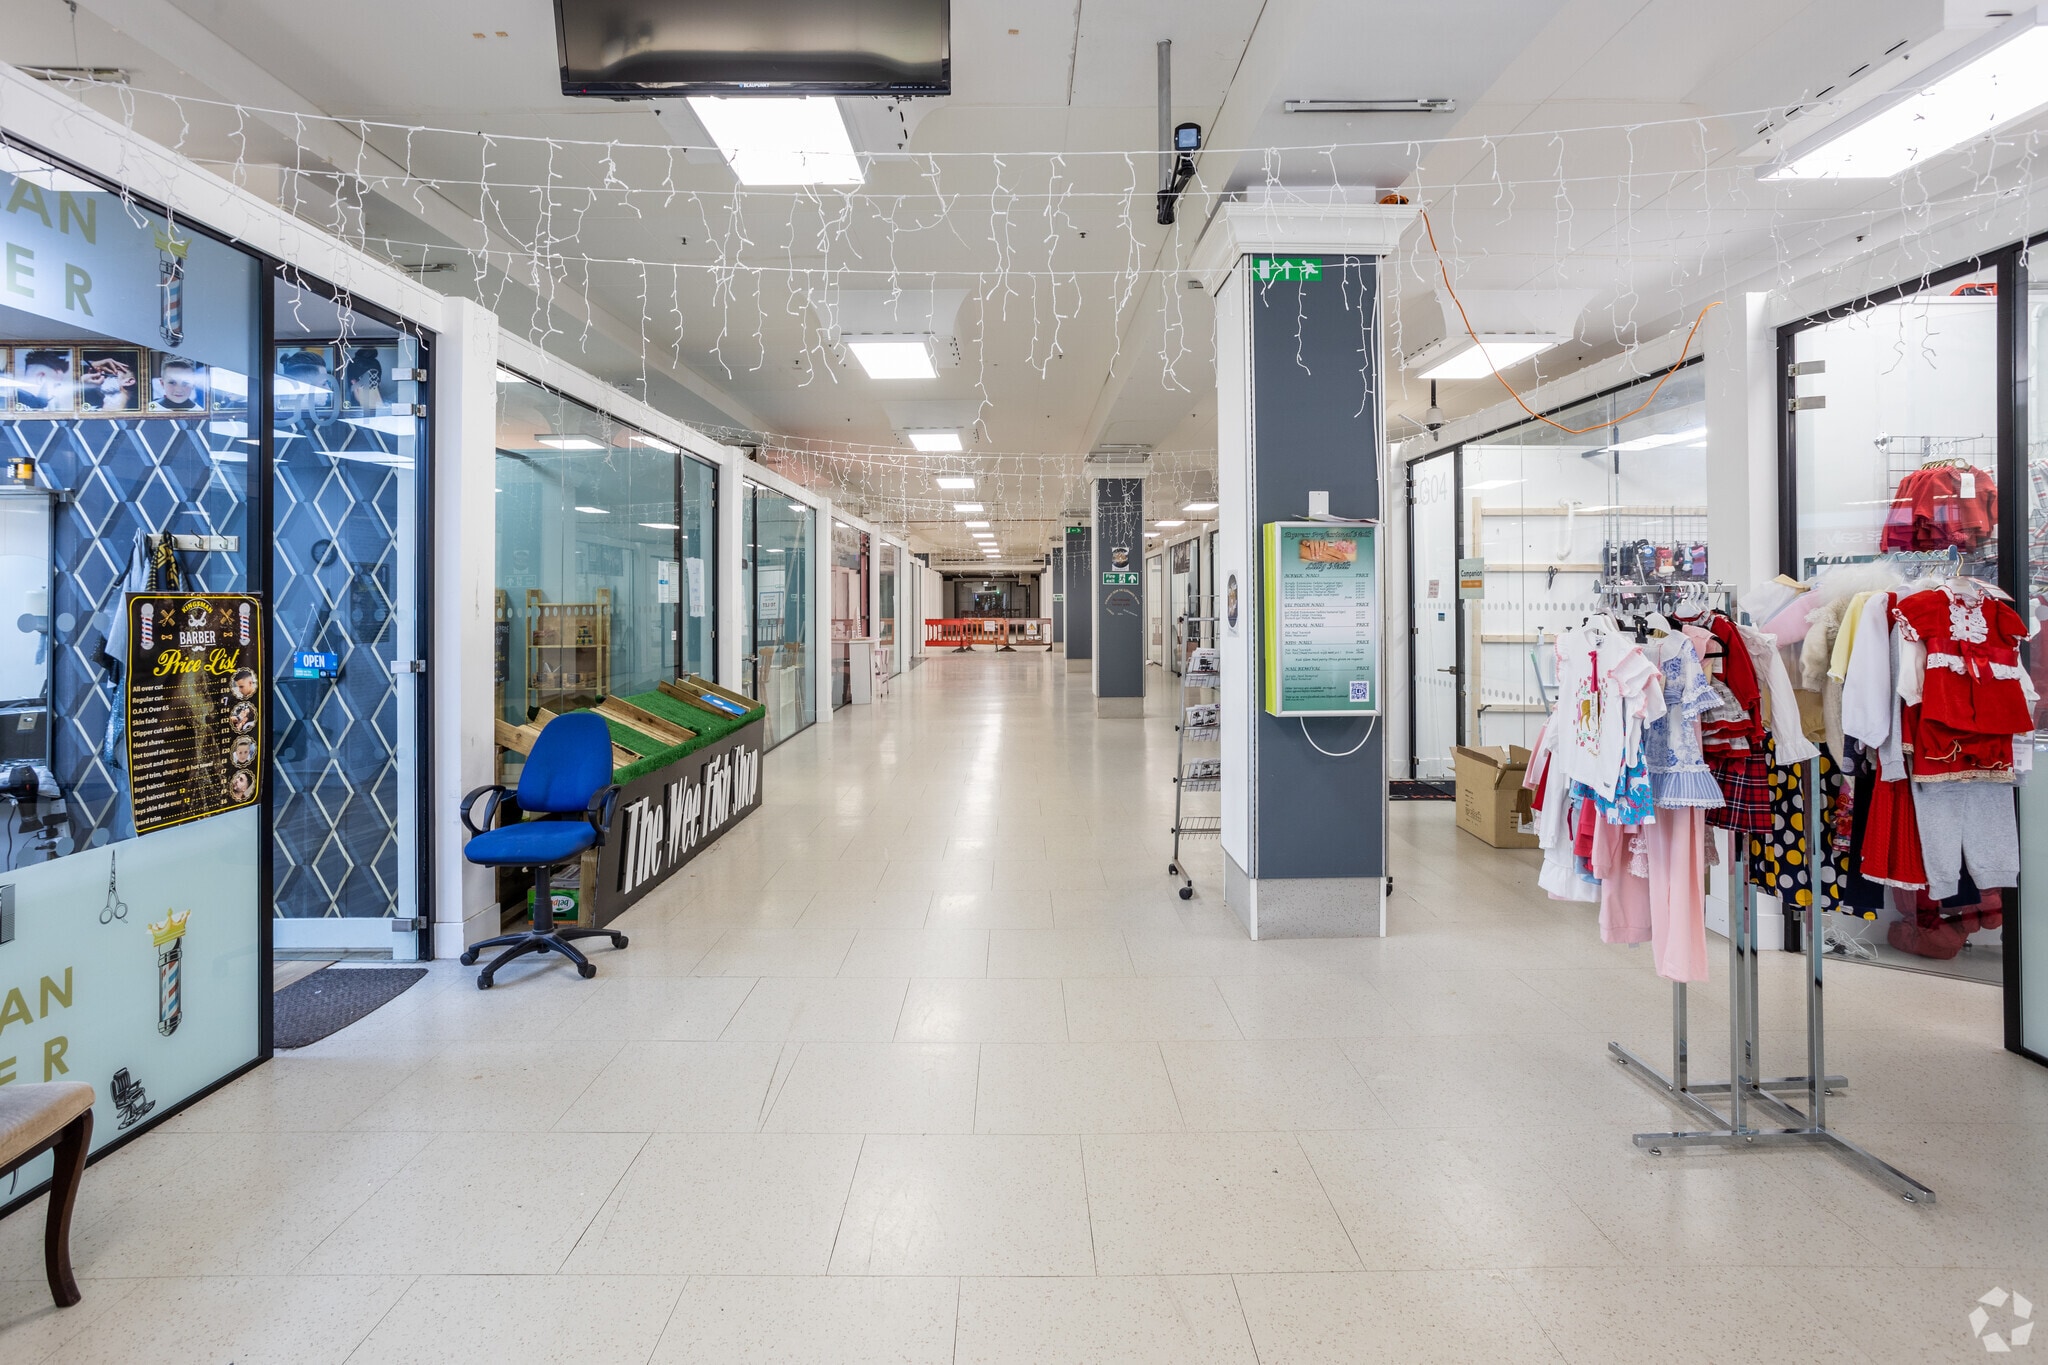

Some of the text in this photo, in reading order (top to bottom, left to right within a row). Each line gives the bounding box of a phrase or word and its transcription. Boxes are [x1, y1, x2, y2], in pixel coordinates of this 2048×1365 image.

[181, 601, 214, 614] KINGSMAN
[179, 630, 216, 645] BARBER
[153, 647, 240, 676] Price List
[303, 654, 326, 668] OPEN
[132, 696, 153, 704] Regular
[132, 719, 145, 727] Skin
[148, 739, 164, 747] shave
[133, 762, 153, 771] Haircut
[134, 786, 146, 794] Boys
[146, 782, 165, 790] haircut
[146, 793, 165, 801] haircut
[146, 805, 158, 813] skin
[625, 744, 758, 895] The Wee Fish Shop
